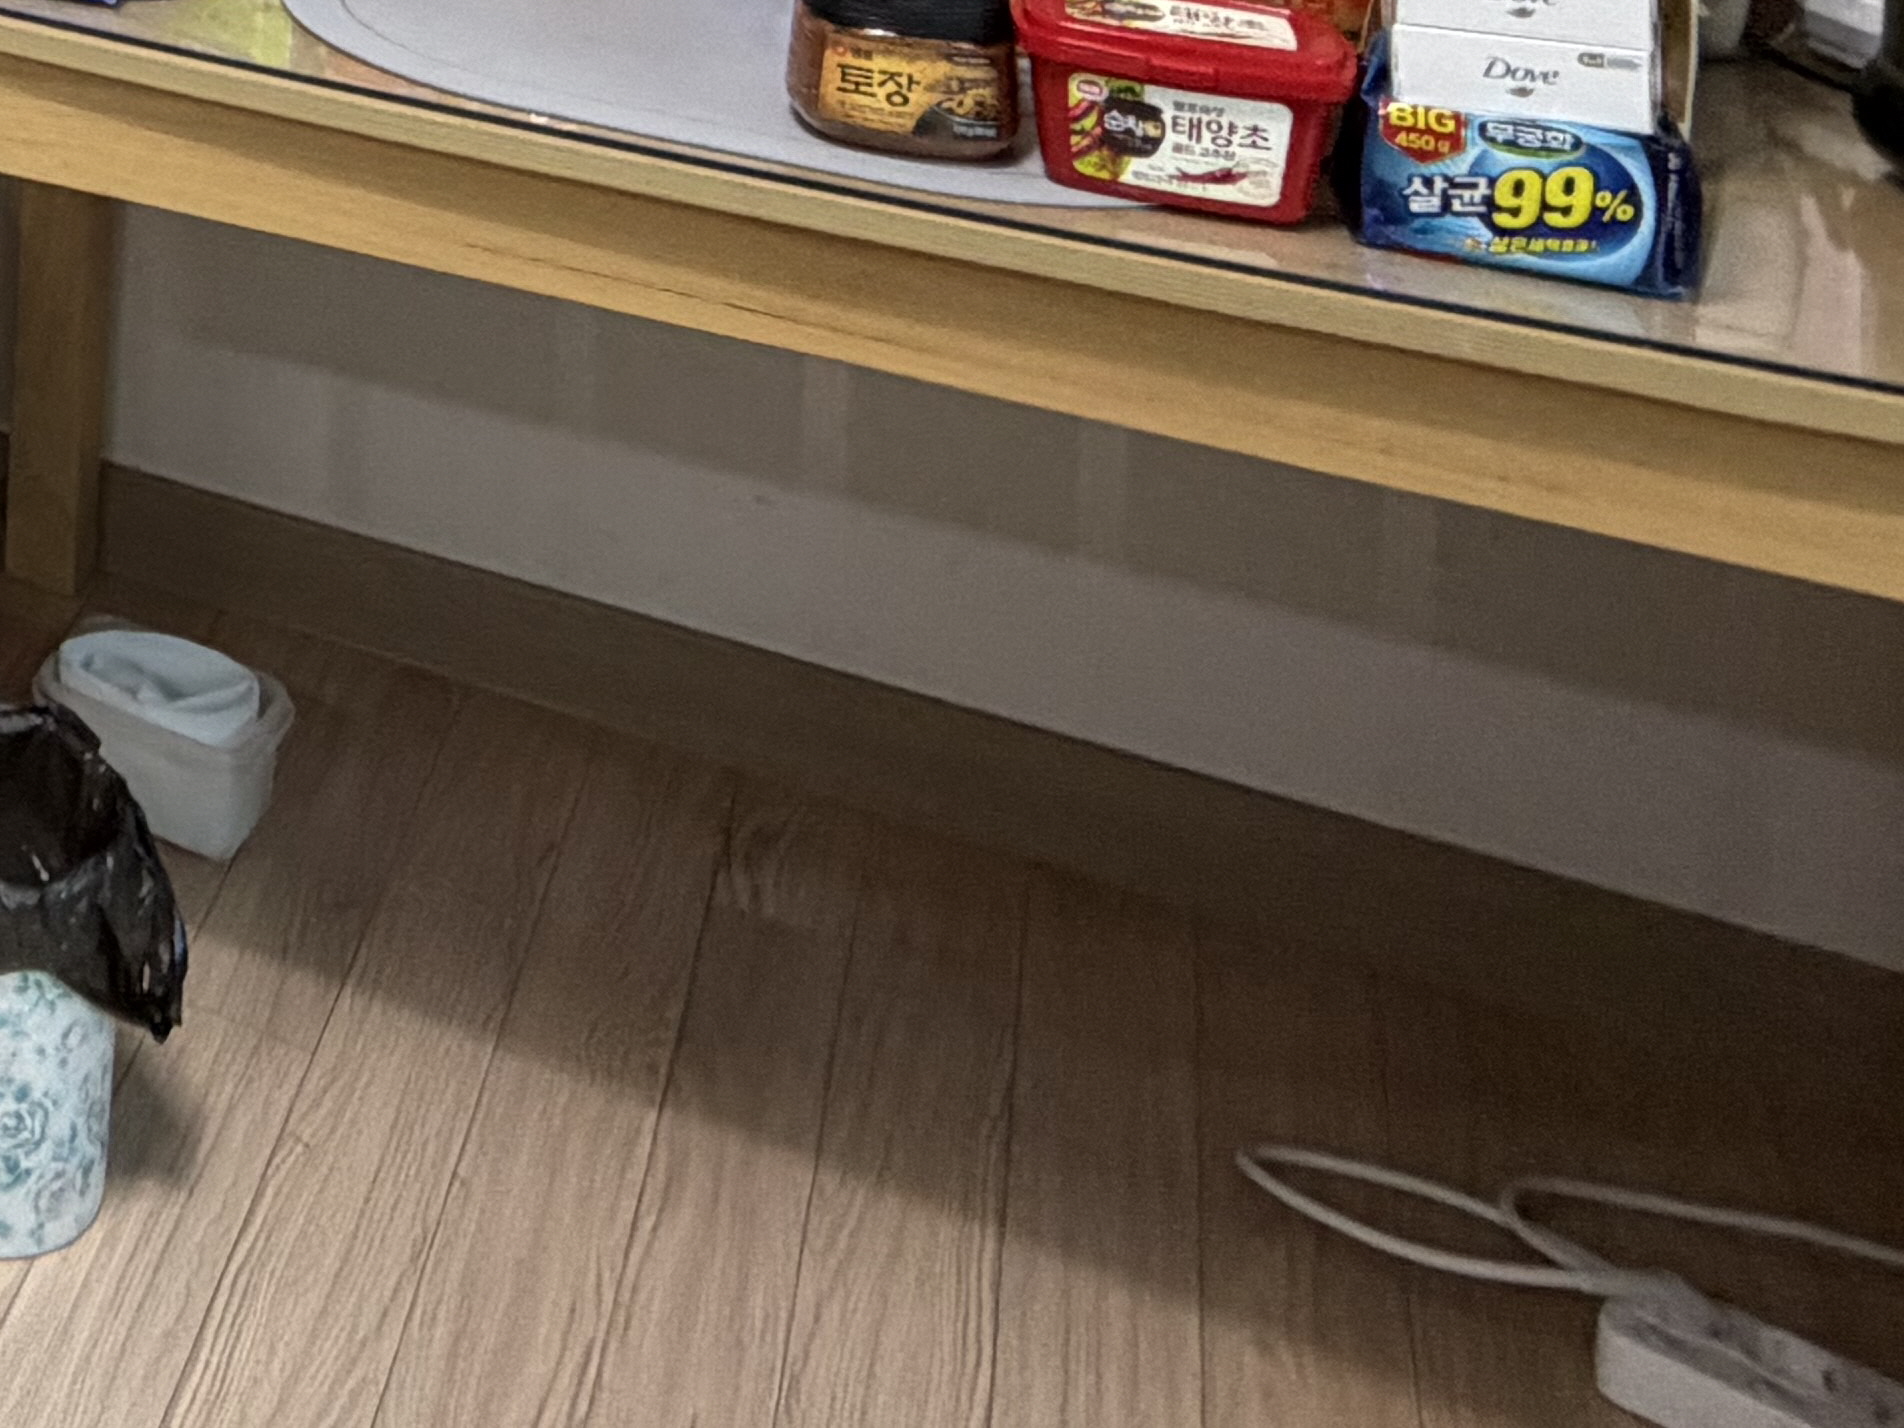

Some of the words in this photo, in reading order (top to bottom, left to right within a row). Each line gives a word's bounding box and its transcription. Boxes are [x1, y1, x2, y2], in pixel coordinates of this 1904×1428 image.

[835, 62, 921, 108] 토장
[1482, 56, 1560, 85] Dove
[1170, 114, 1272, 151] 태양초
[1387, 101, 1456, 133] BIG
[1395, 130, 1435, 150] 450
[1484, 121, 1574, 151] 무궁화
[1402, 176, 1491, 215] 살균
[1492, 166, 1635, 230] 99%
